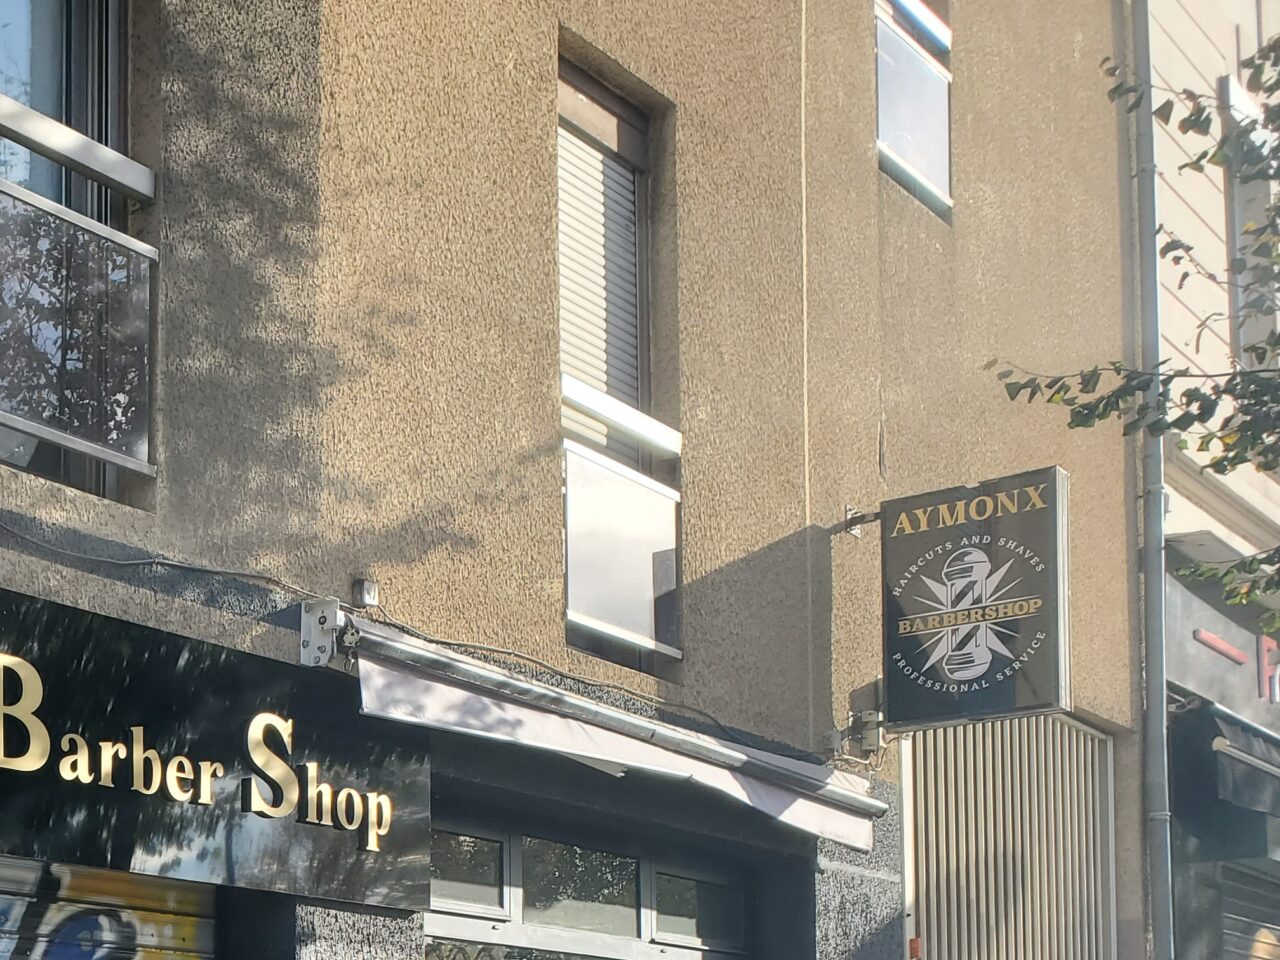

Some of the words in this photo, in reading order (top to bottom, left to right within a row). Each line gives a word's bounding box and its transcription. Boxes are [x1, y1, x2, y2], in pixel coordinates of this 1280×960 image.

[890, 483, 1048, 537] AYMONX
[892, 541, 953, 598] HAIRCUTS
[960, 534, 991, 546] AND
[998, 536, 1045, 573] SHAVES
[897, 598, 1043, 636] BARBERSHOP
[892, 652, 989, 693] PROFESSIONAL
[996, 631, 1046, 682] SERVICE
[243, 712, 393, 853] Shop
